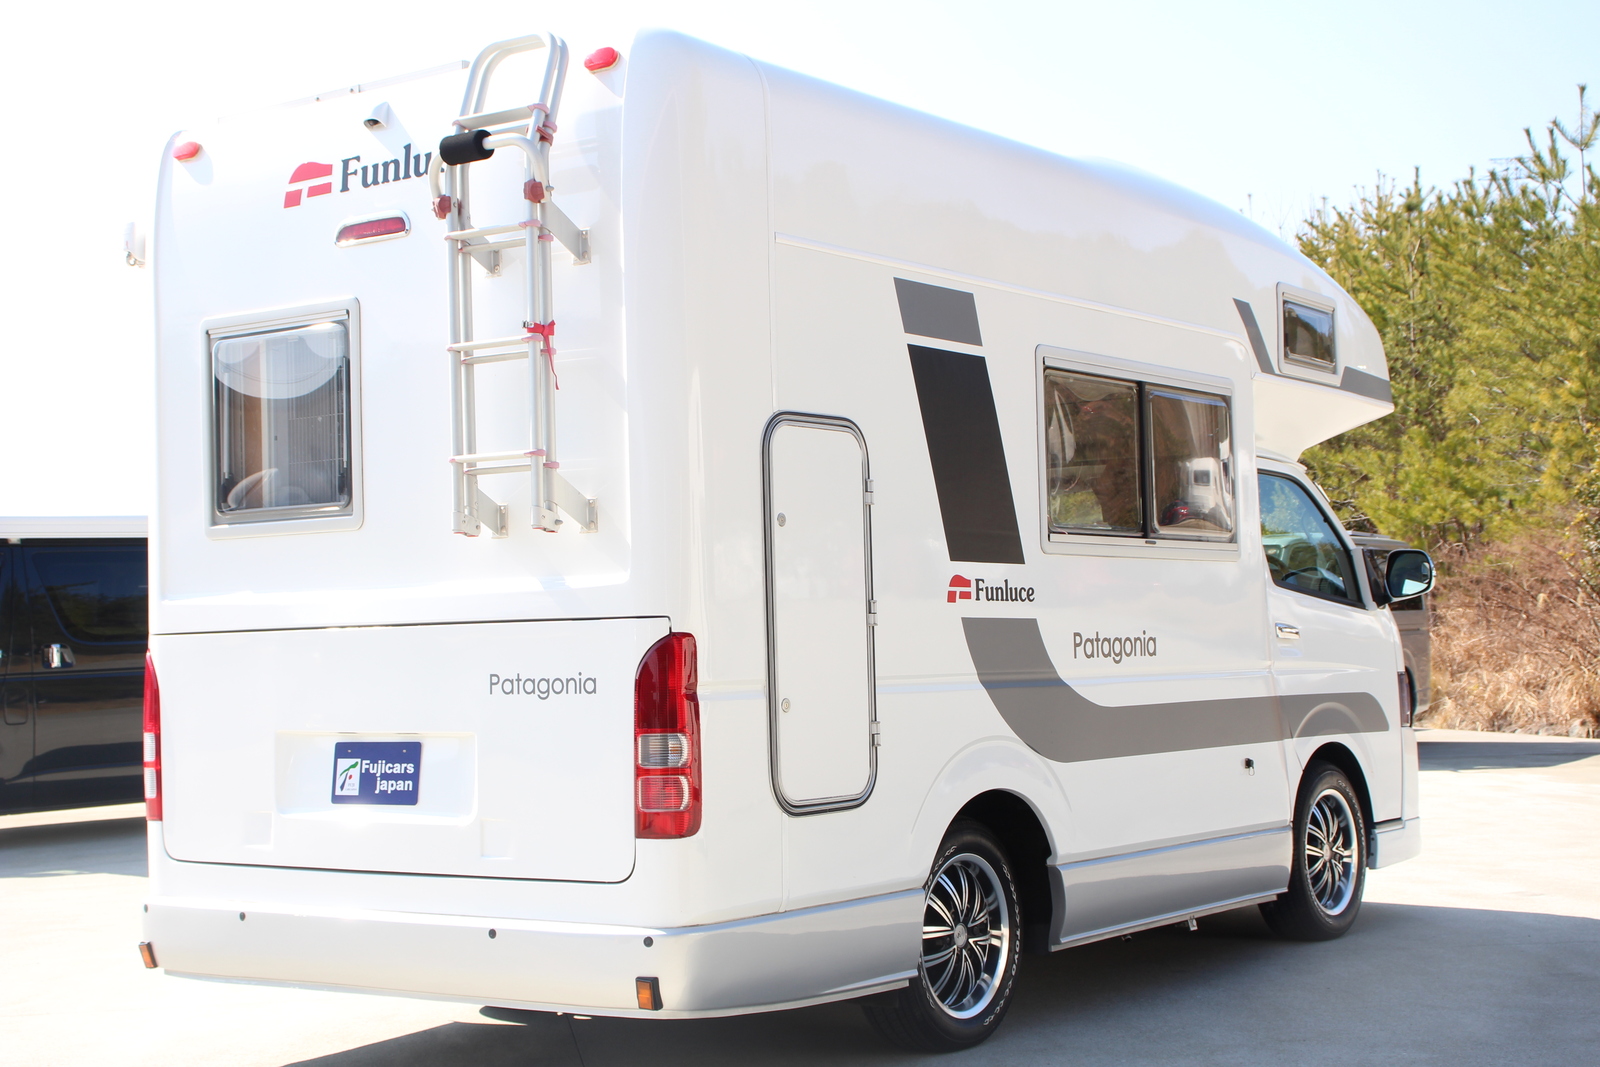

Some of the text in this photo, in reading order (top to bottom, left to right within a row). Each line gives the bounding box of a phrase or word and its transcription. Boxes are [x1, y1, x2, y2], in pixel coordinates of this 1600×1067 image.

[340, 142, 445, 193] Funlu
[974, 578, 1036, 602] Funluce
[1073, 630, 1157, 665] Patagonia
[489, 671, 597, 700] Patagonia
[361, 759, 415, 777] Fujicars
[374, 776, 413, 794] japan
